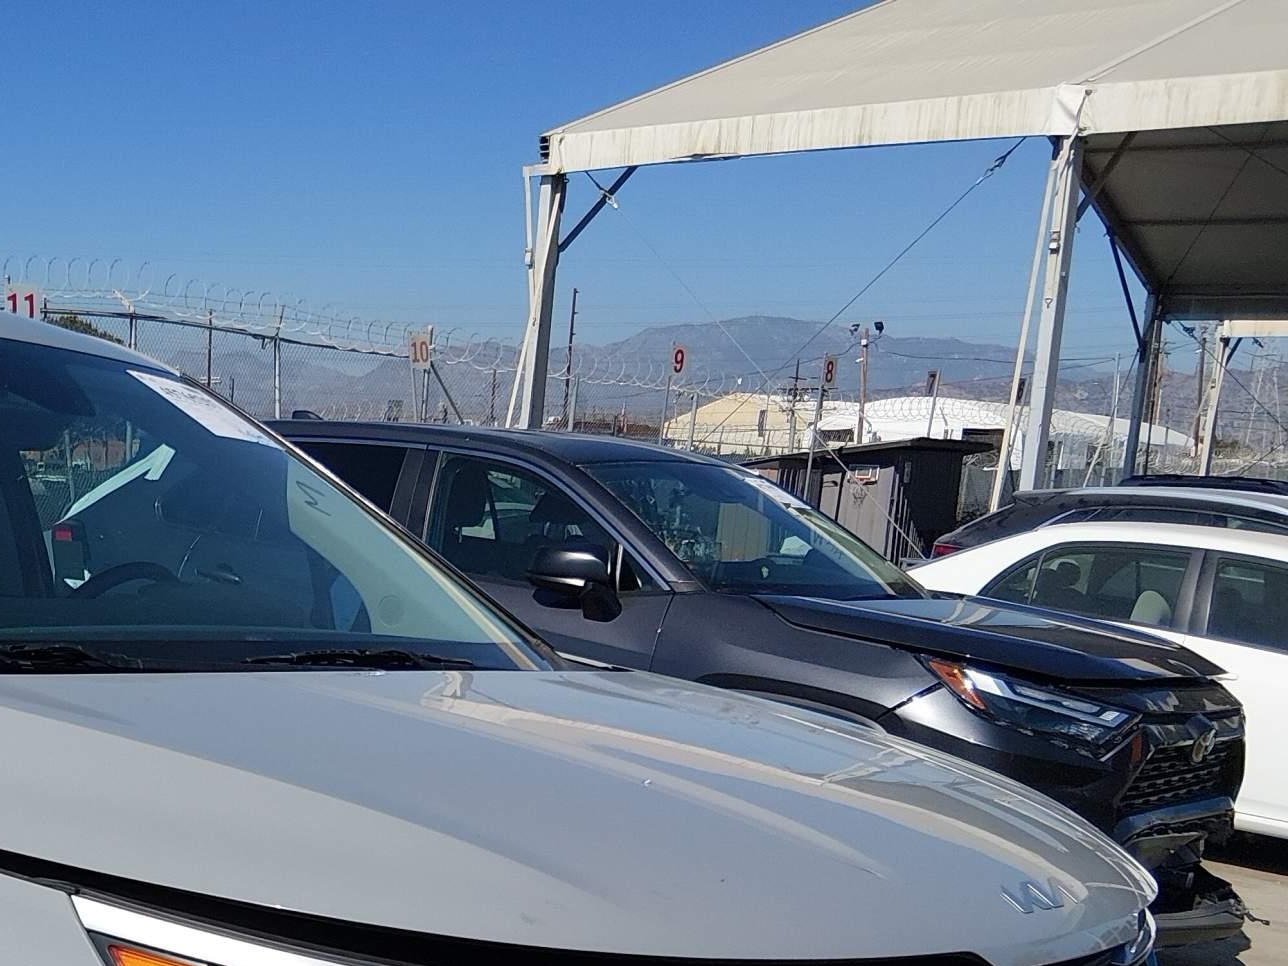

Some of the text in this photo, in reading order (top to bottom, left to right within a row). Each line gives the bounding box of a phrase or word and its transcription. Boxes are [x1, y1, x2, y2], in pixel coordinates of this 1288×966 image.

[7, 292, 34, 319] 11
[411, 341, 429, 363] 10
[674, 349, 684, 373] 9
[825, 361, 834, 383] 8
